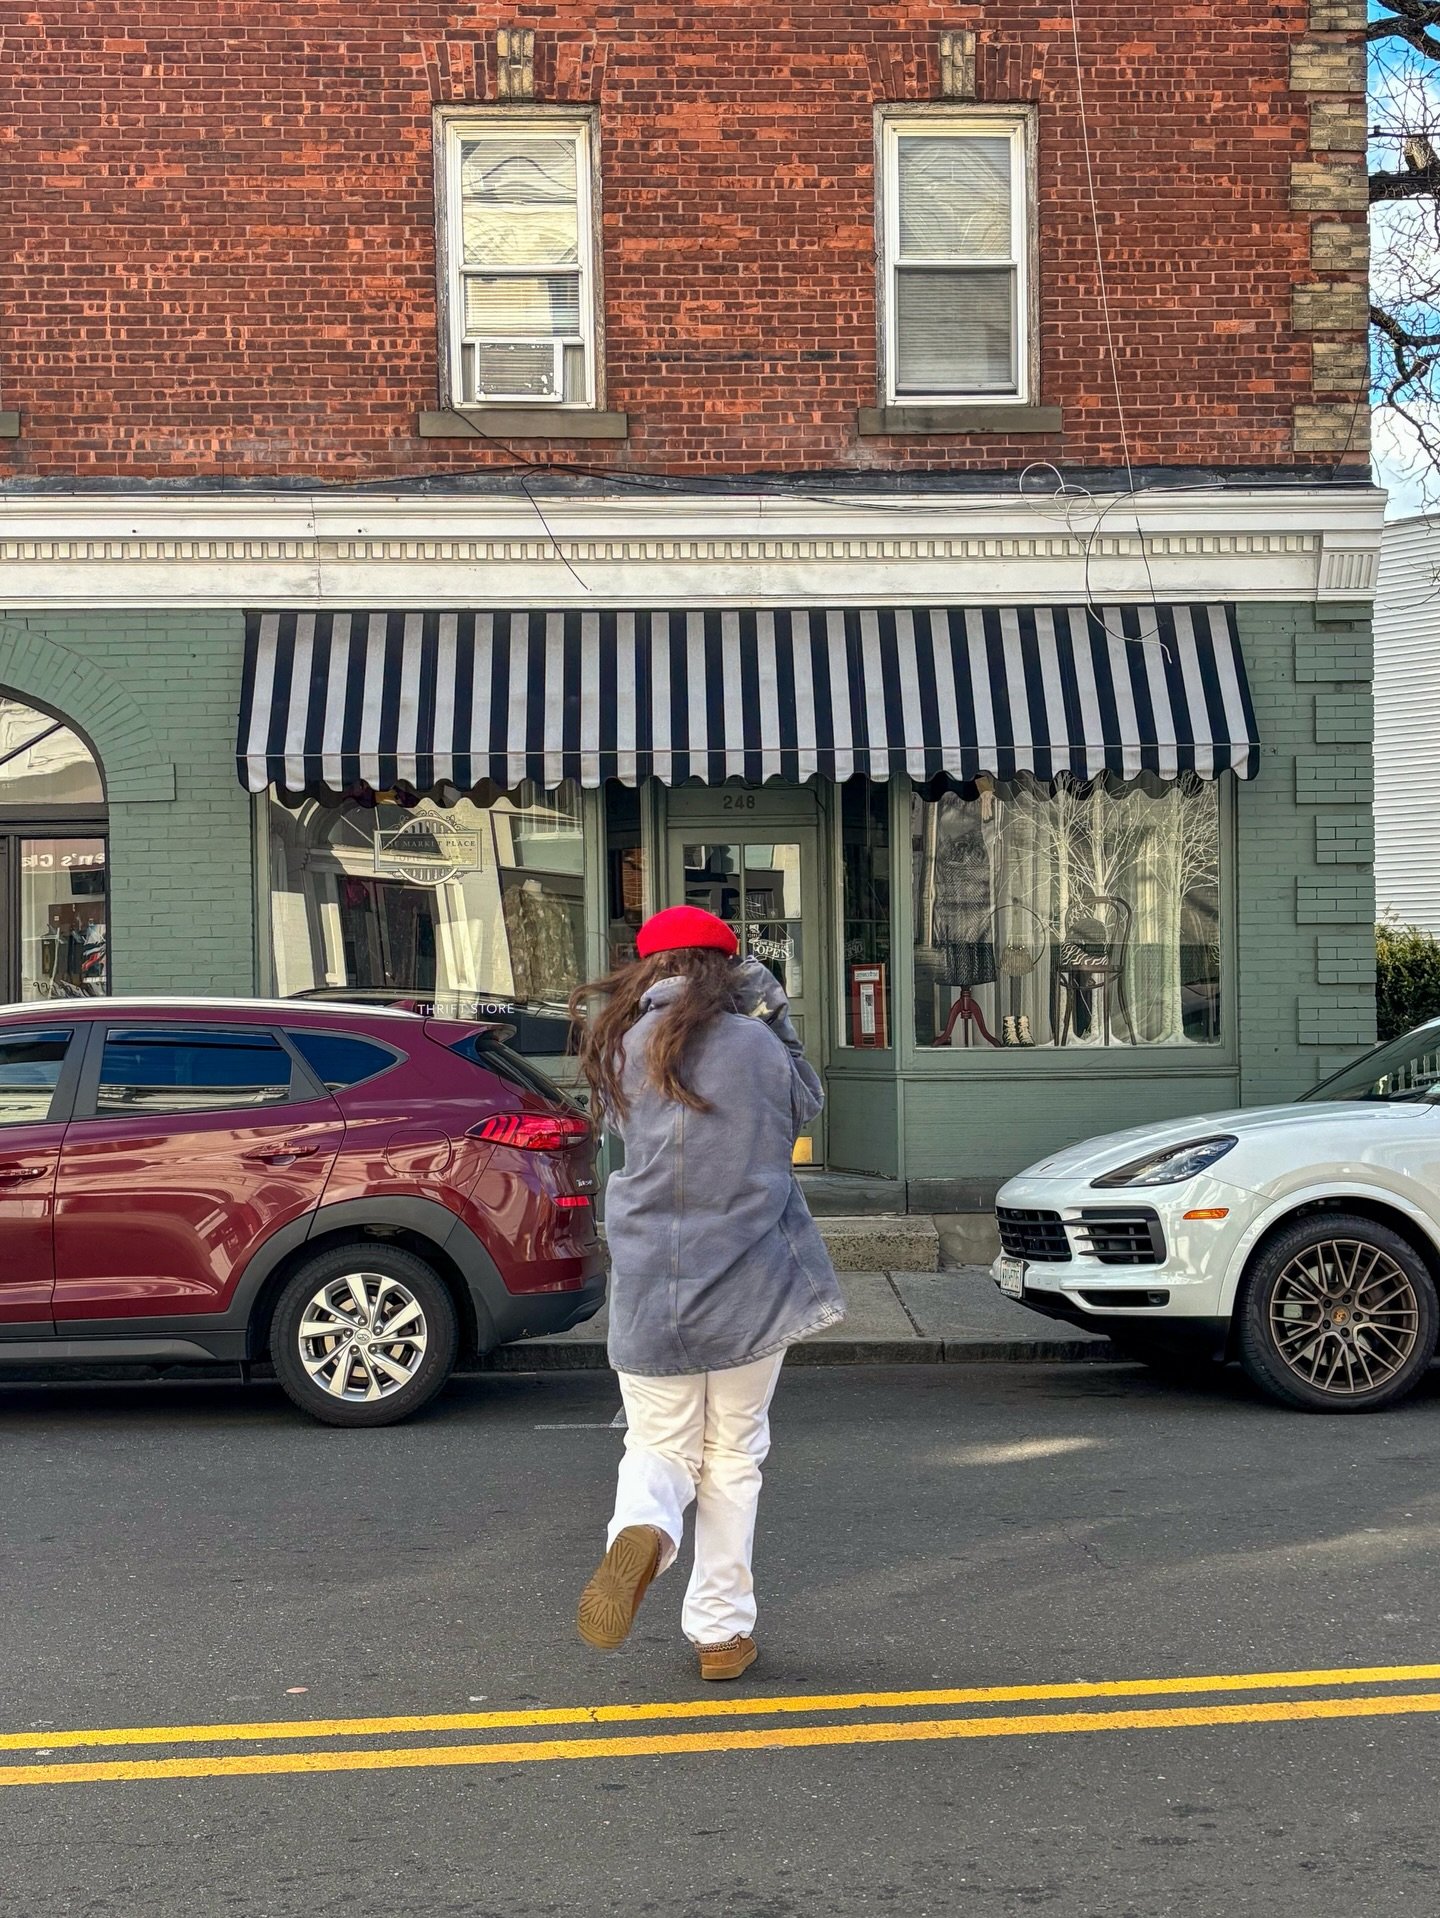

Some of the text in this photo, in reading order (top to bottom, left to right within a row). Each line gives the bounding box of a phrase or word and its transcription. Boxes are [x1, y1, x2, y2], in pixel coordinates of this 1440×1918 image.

[723, 795, 755, 809] 248
[403, 840, 442, 848] MARKET
[446, 840, 476, 848] PLACE
[757, 944, 790, 959] OPEN
[417, 1003, 515, 1015] THRIFT STORE
